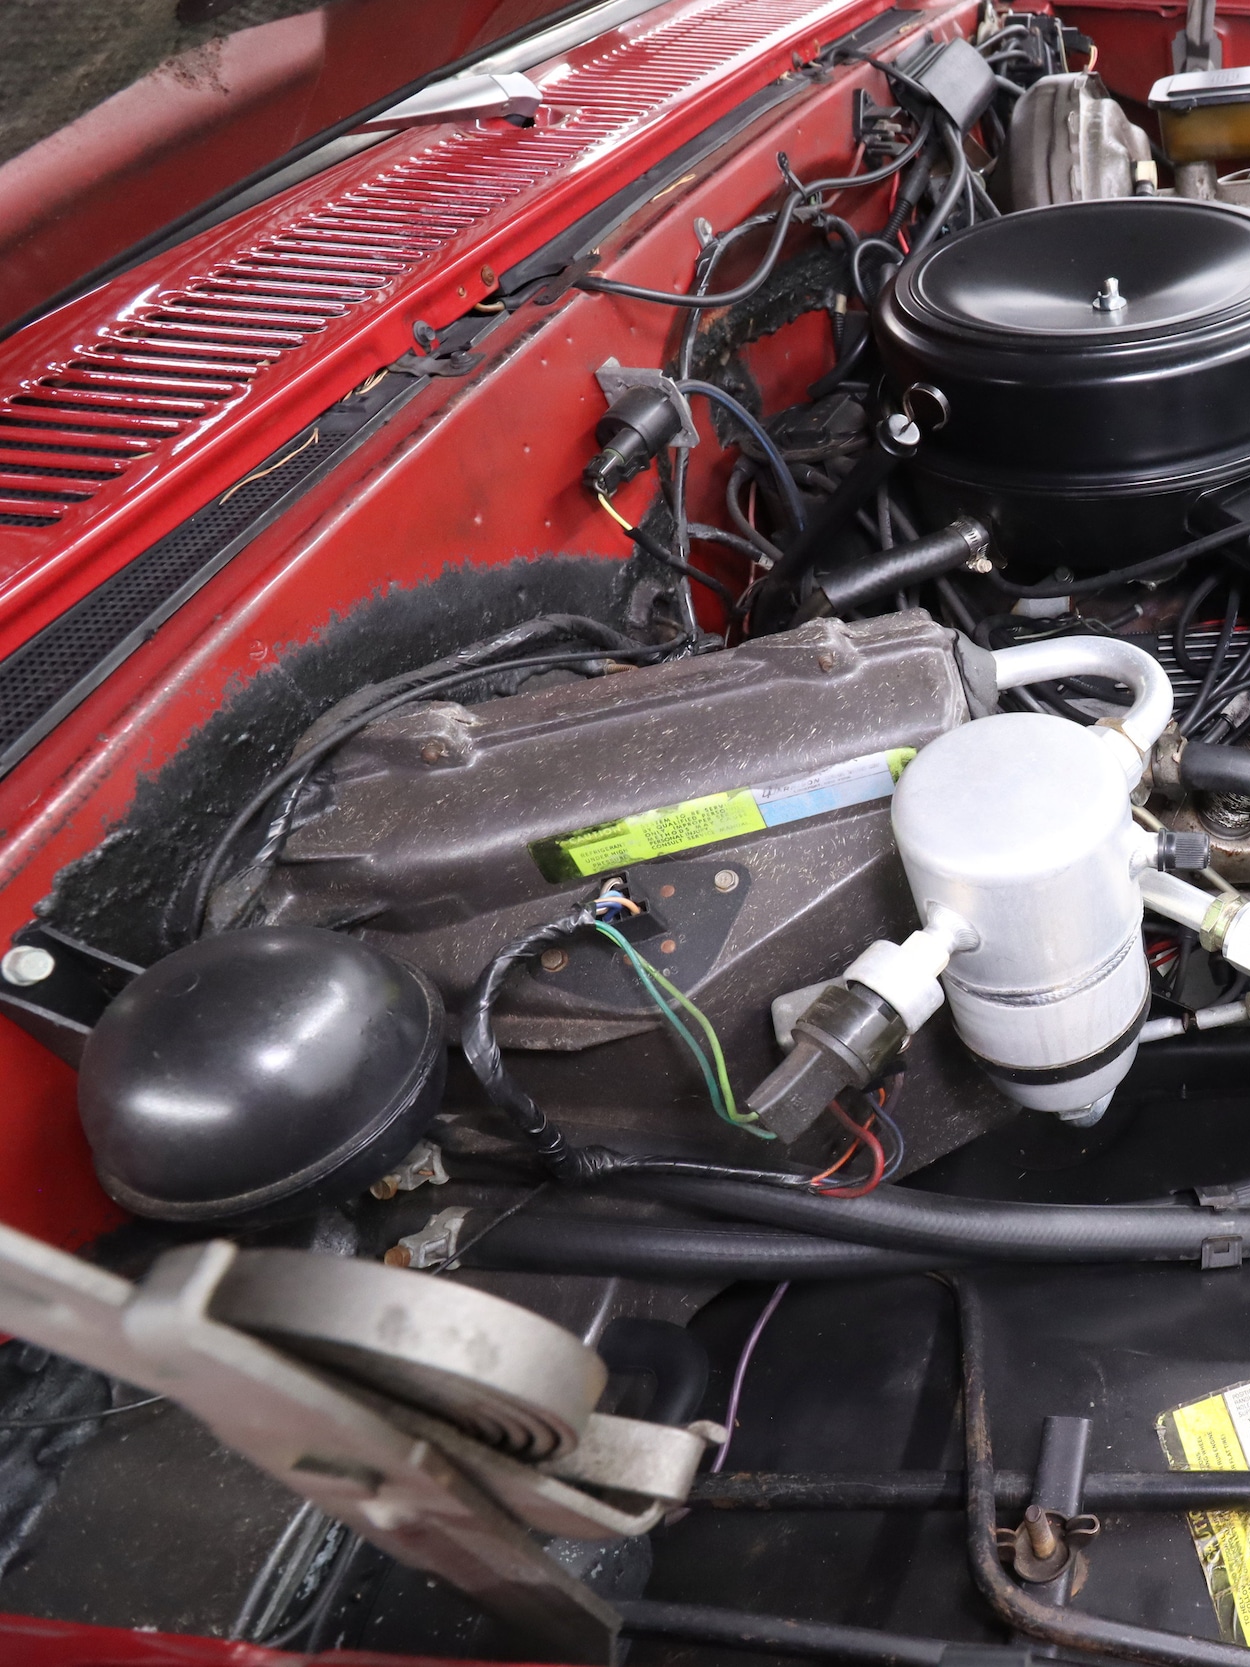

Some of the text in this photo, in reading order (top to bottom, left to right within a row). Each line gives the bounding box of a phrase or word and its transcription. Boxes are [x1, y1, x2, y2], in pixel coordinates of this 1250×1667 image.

[656, 815, 697, 829] QUALIFIED
[672, 817, 711, 830] IMPROPER
[568, 825, 621, 844] CAUTION
[646, 827, 689, 841] METHODS
[649, 833, 684, 846] PERSONAL
[651, 838, 683, 850] CONSULT
[585, 848, 628, 863] UNDER HIGH
[1206, 1430, 1222, 1465] RUN ENGINE
[1225, 1449, 1234, 1464] FLAT
[1243, 1614, 1250, 1624] TO
